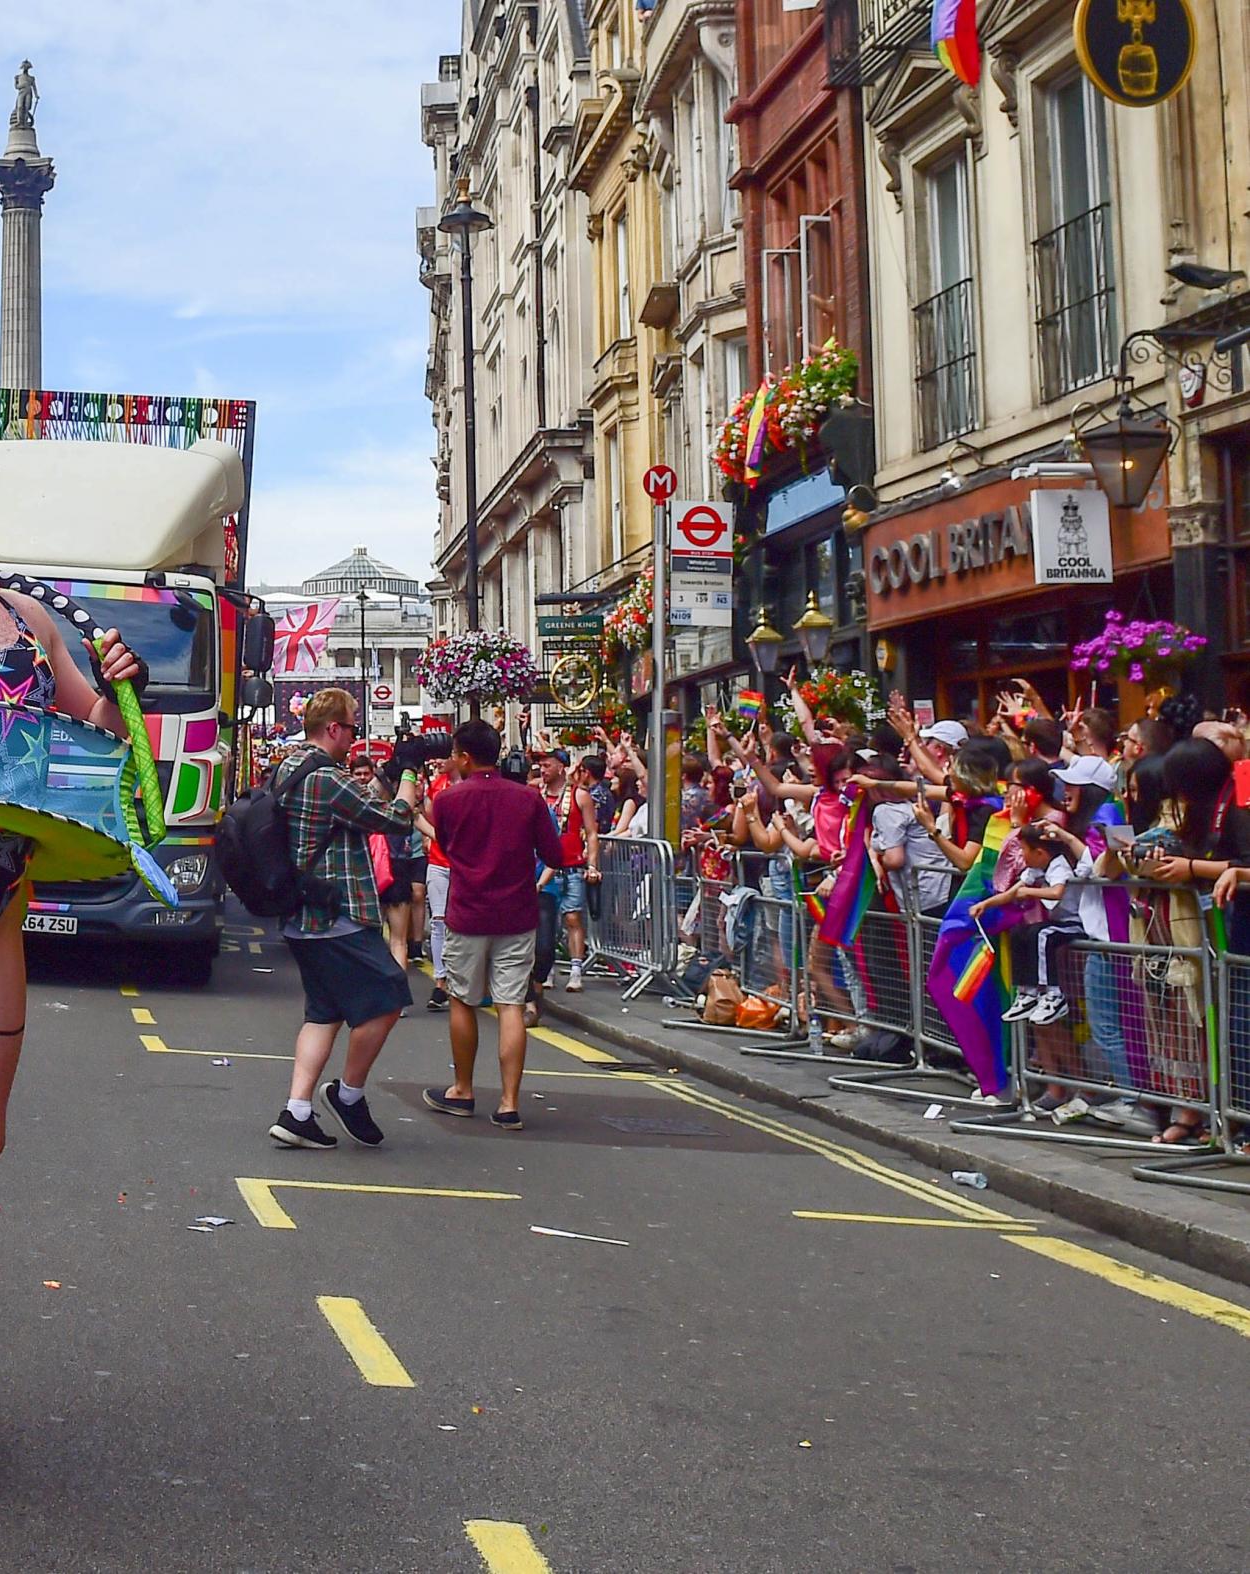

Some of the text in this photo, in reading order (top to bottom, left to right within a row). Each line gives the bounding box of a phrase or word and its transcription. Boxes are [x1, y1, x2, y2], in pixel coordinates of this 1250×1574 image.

[649, 470, 672, 493] M
[869, 530, 944, 594] COOL
[1058, 557, 1093, 567] COOL
[1046, 568, 1106, 578] BRITANNIA
[671, 612, 692, 620] N109
[577, 621, 598, 629] KING
[49, 918, 75, 932] ZSU
